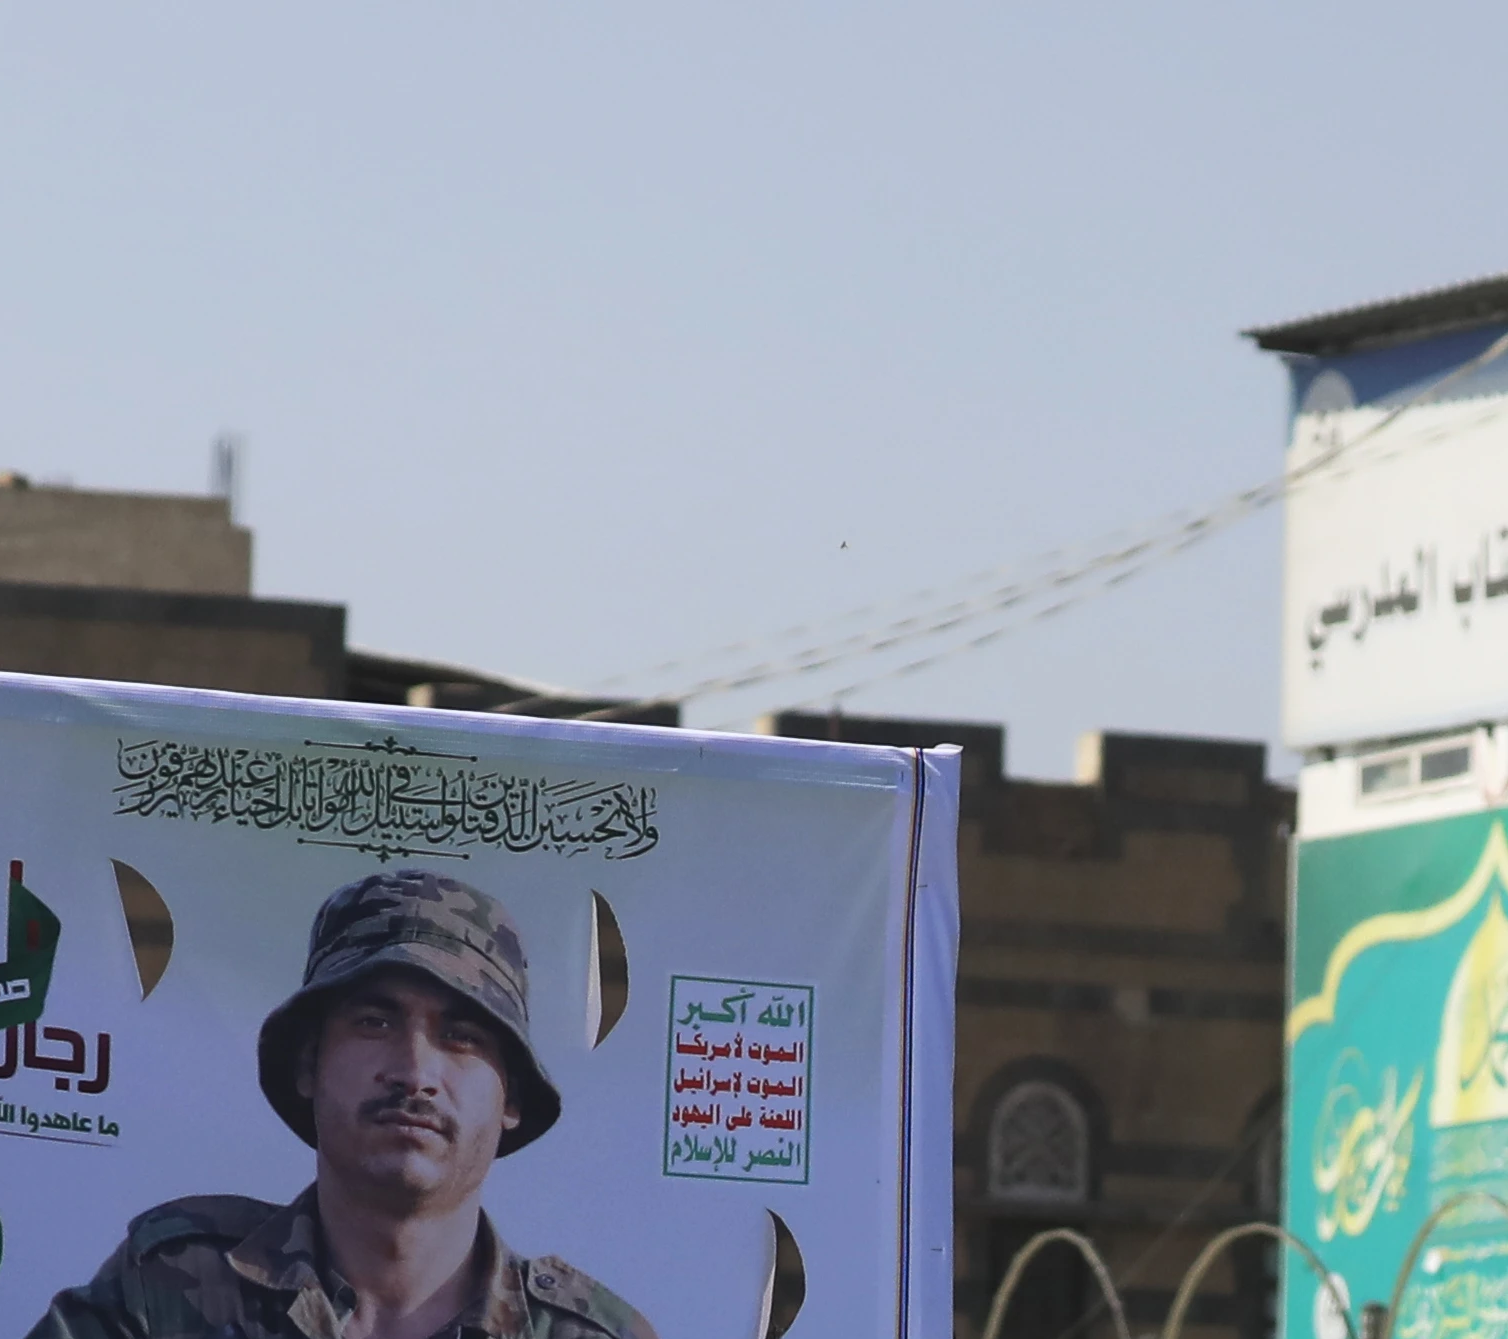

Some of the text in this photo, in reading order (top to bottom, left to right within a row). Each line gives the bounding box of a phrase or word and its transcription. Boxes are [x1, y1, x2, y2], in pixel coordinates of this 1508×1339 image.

[676, 986, 805, 1031] الله أكبر
[748, 1041, 804, 1066] الموت
[746, 1076, 803, 1100] الموت
[21, 1106, 92, 1133] عاهدوا
[98, 1115, 120, 1138] ما
[672, 1103, 803, 1131] اللعنة على اليهود
[742, 1137, 801, 1173] النصر
